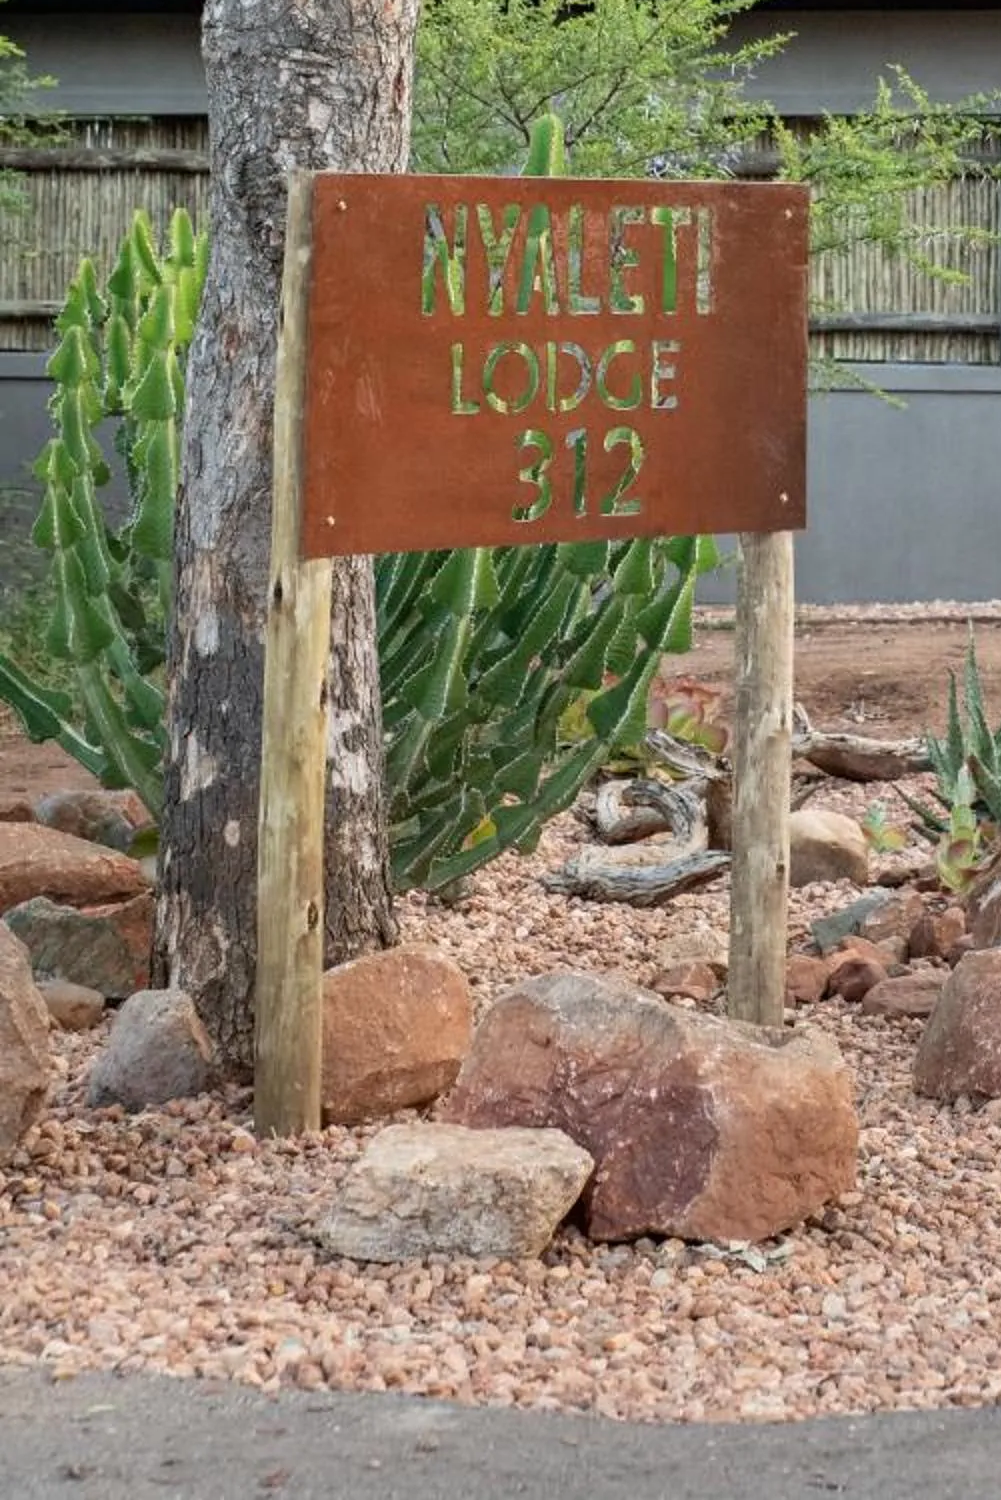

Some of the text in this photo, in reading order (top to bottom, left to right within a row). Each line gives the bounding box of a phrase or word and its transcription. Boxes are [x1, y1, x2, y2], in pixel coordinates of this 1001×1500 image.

[421, 203, 715, 315] NYALETI
[451, 339, 682, 415] LODGE
[512, 426, 645, 522] 312
